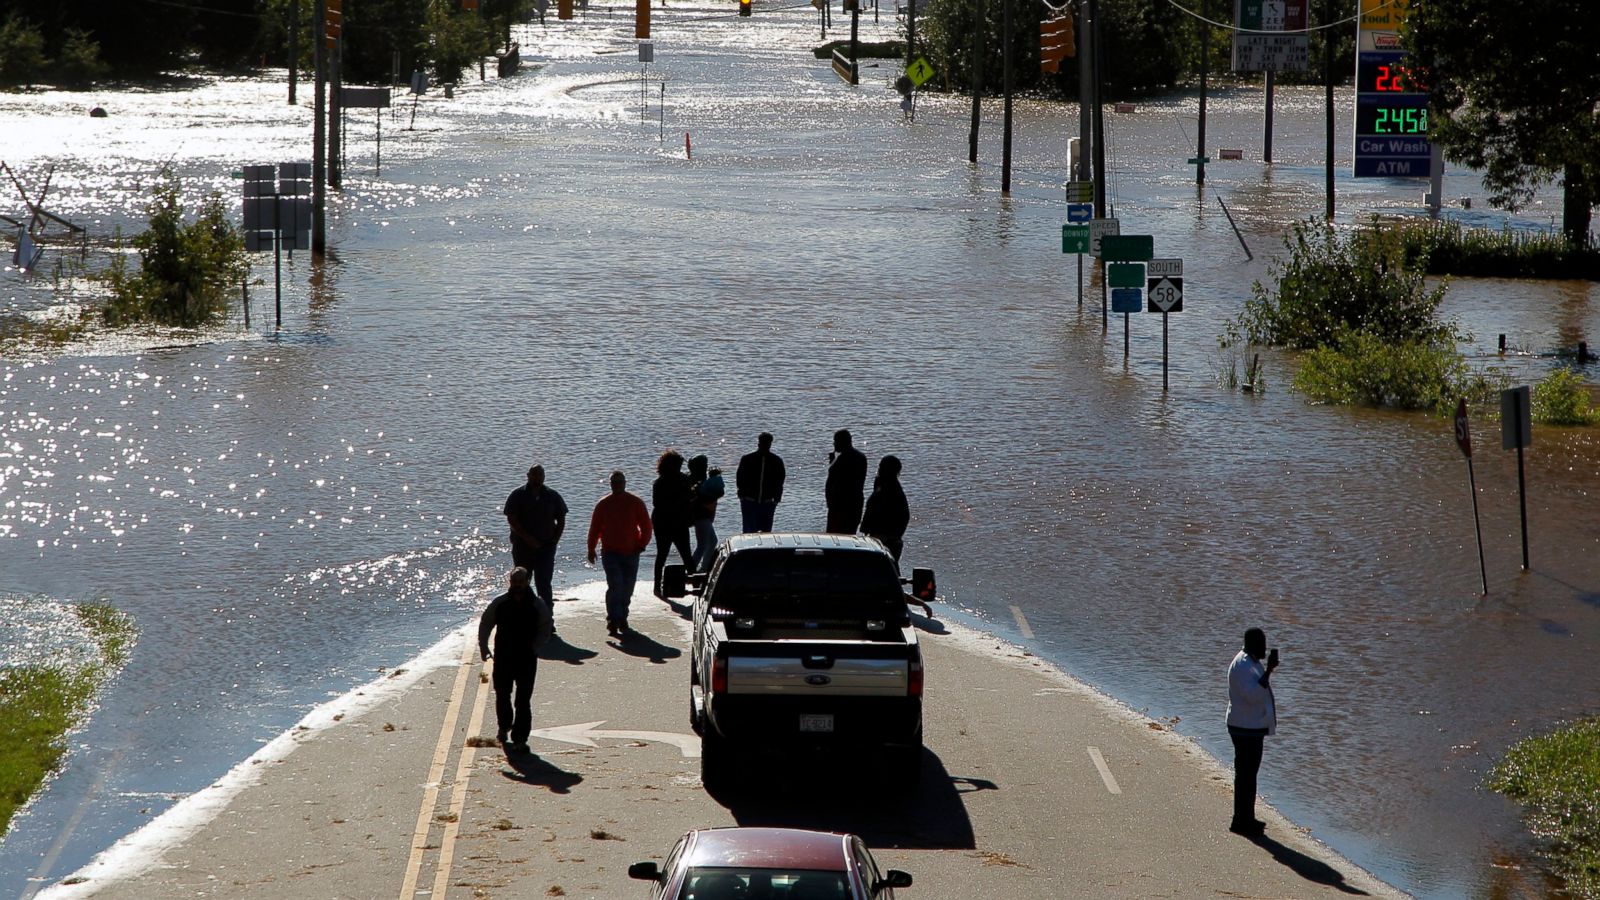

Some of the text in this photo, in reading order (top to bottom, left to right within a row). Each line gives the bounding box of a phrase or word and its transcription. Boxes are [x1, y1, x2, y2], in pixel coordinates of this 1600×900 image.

[1238, 45, 1253, 53] SUN
[1263, 54, 1276, 62] SAT
[1257, 62, 1277, 70] TACO
[1283, 62, 1302, 70] BELL
[1375, 108, 1418, 133] 2.45
[1360, 141, 1428, 152] Car Wash
[1376, 162, 1410, 174] ATM
[1091, 222, 1116, 230] SPEED
[1063, 230, 1089, 238] DOWNTO
[1149, 262, 1180, 273] SOUTH
[1156, 287, 1175, 303] 58
